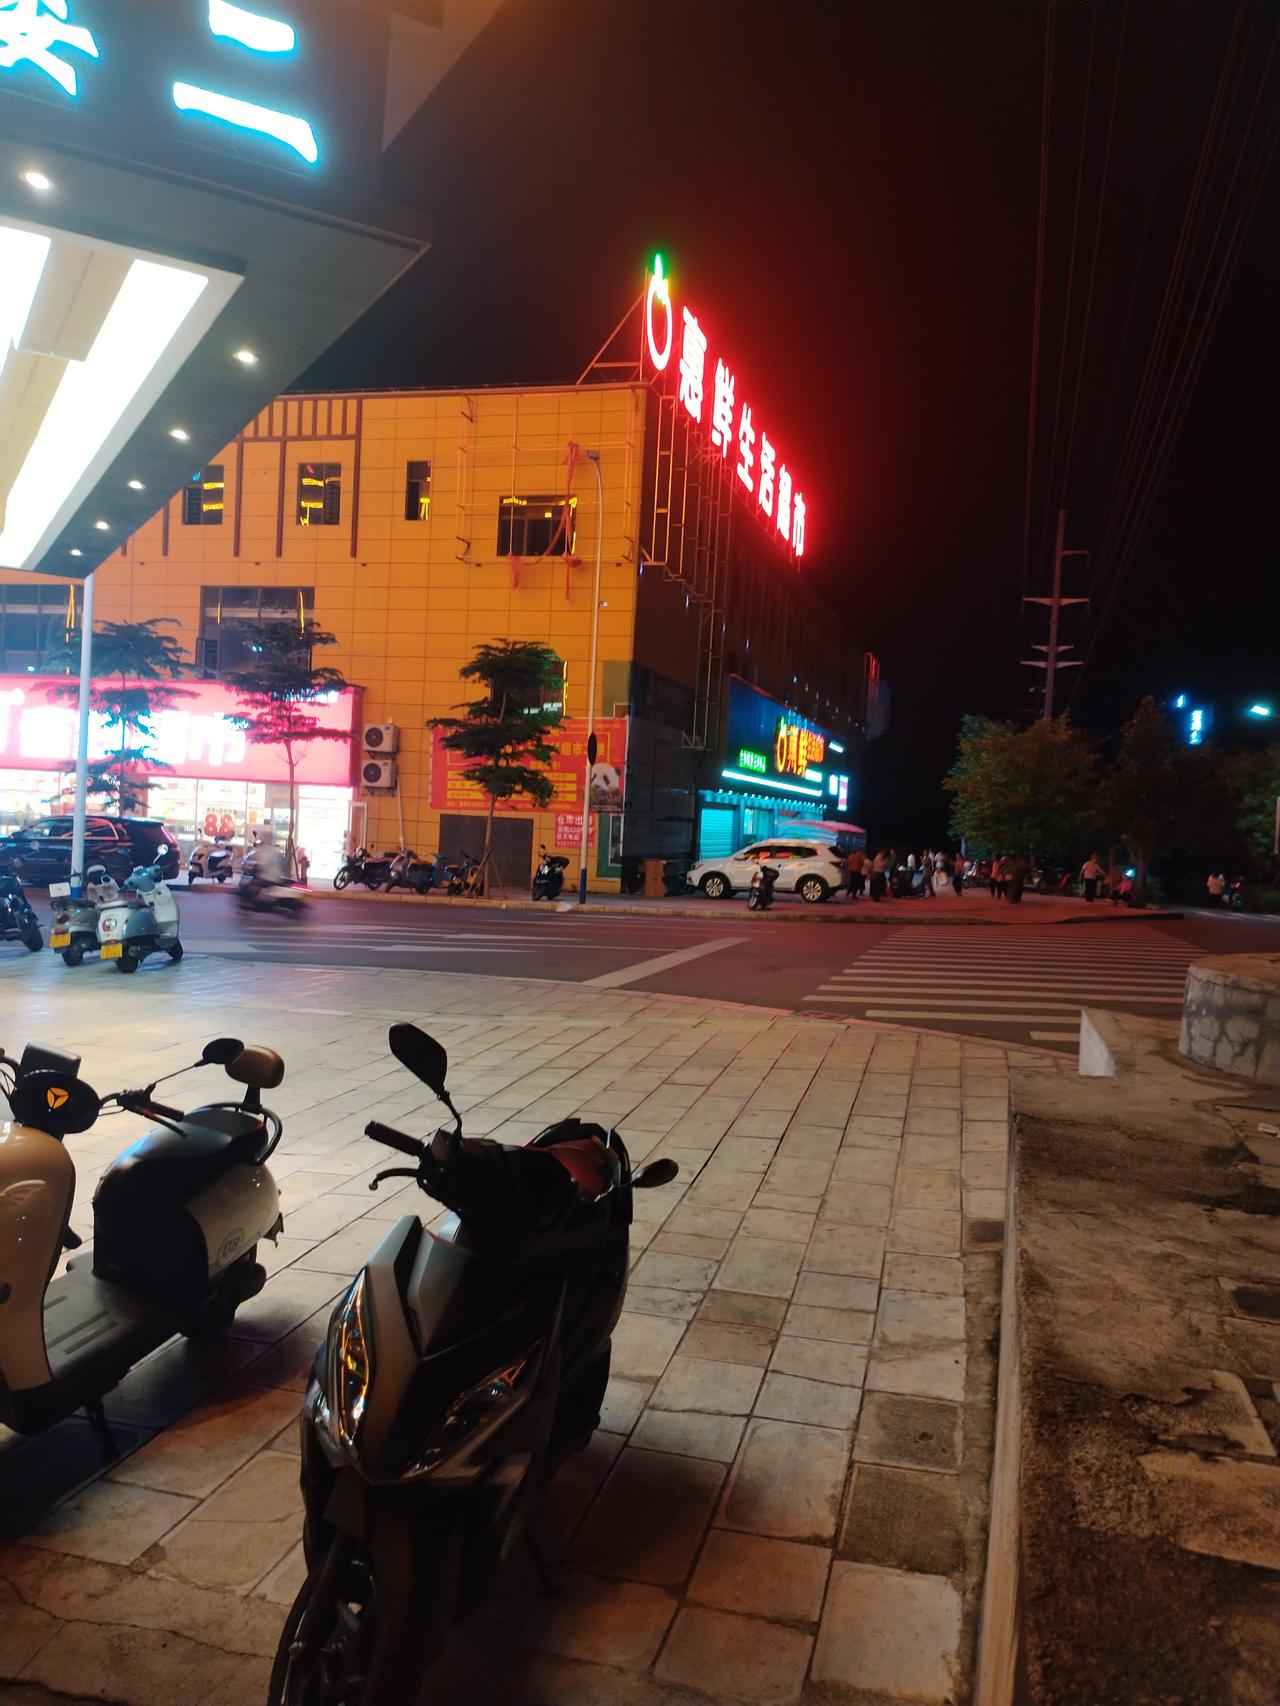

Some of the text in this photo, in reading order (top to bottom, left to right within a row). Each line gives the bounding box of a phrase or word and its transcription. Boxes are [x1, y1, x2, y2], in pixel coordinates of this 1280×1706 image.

[679, 306, 806, 557] 惠鲜生活超市
